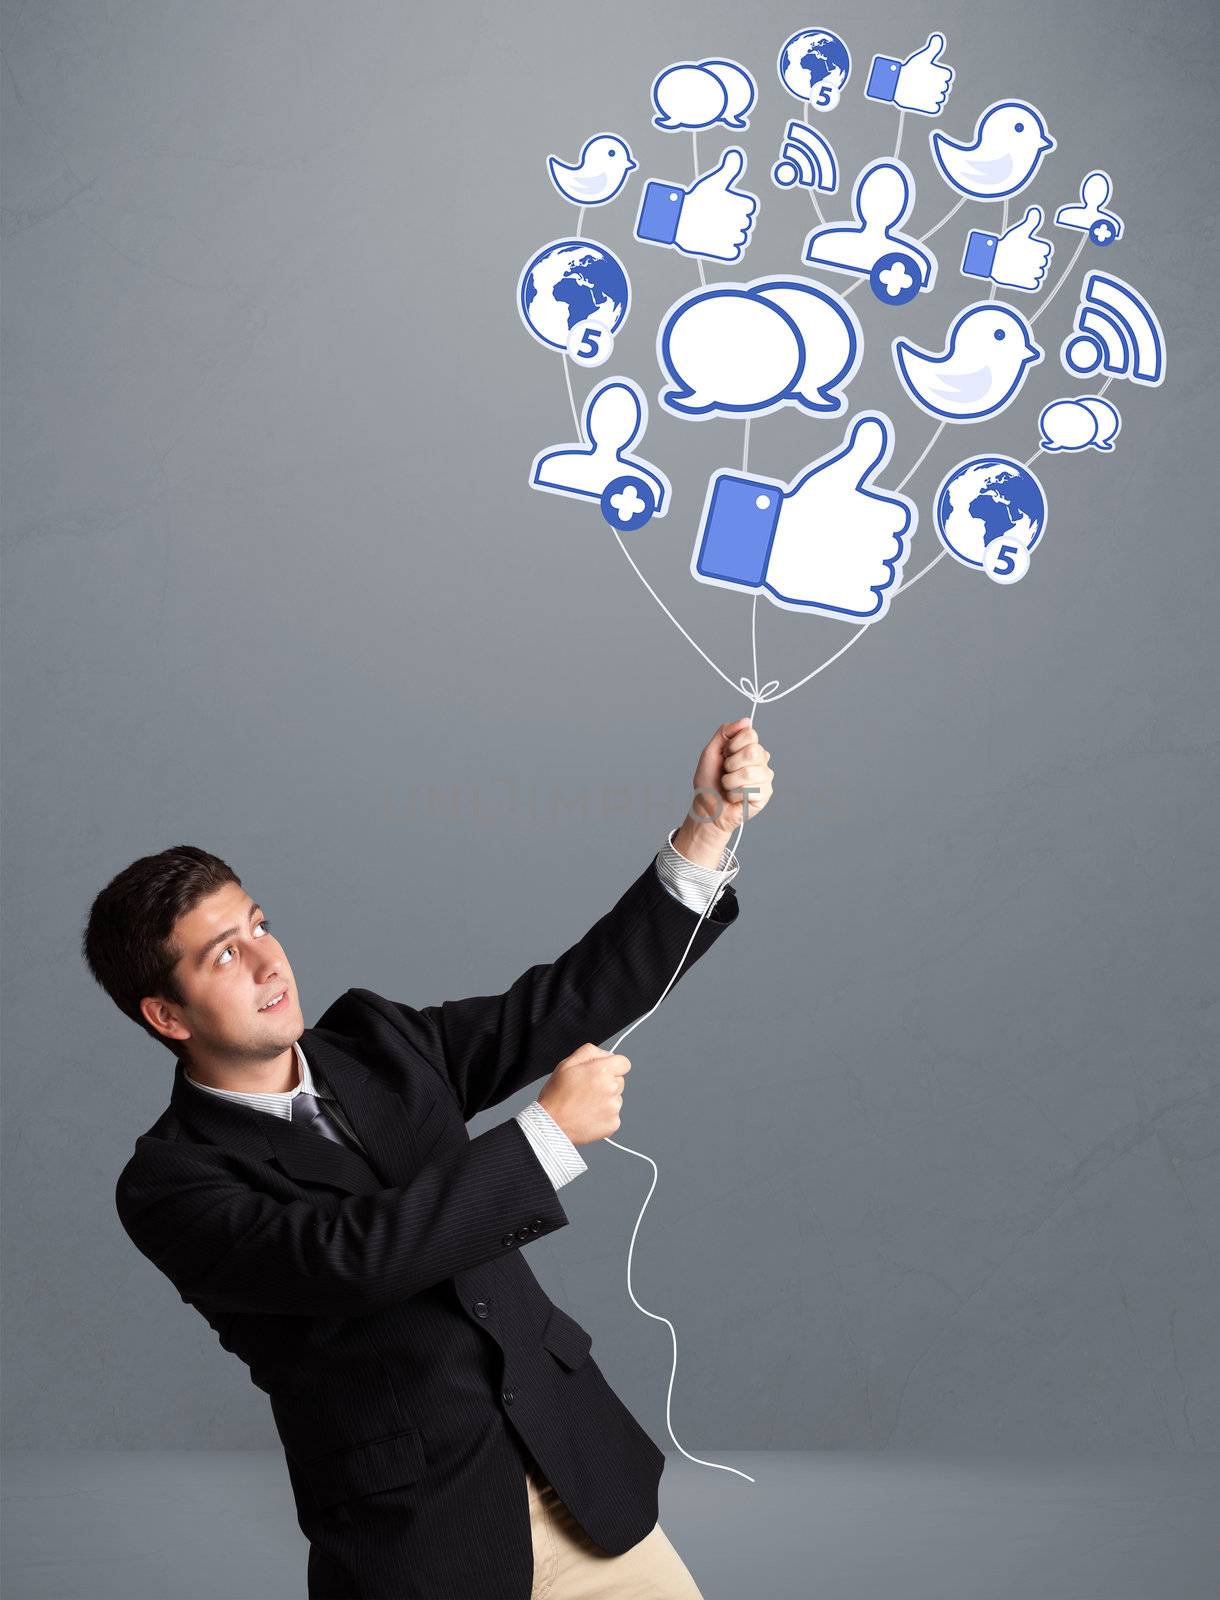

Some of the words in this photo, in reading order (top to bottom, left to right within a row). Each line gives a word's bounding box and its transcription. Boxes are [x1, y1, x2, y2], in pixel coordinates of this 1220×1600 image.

[817, 86, 832, 106] 5
[577, 328, 601, 358] 5
[993, 545, 1018, 575] 5
